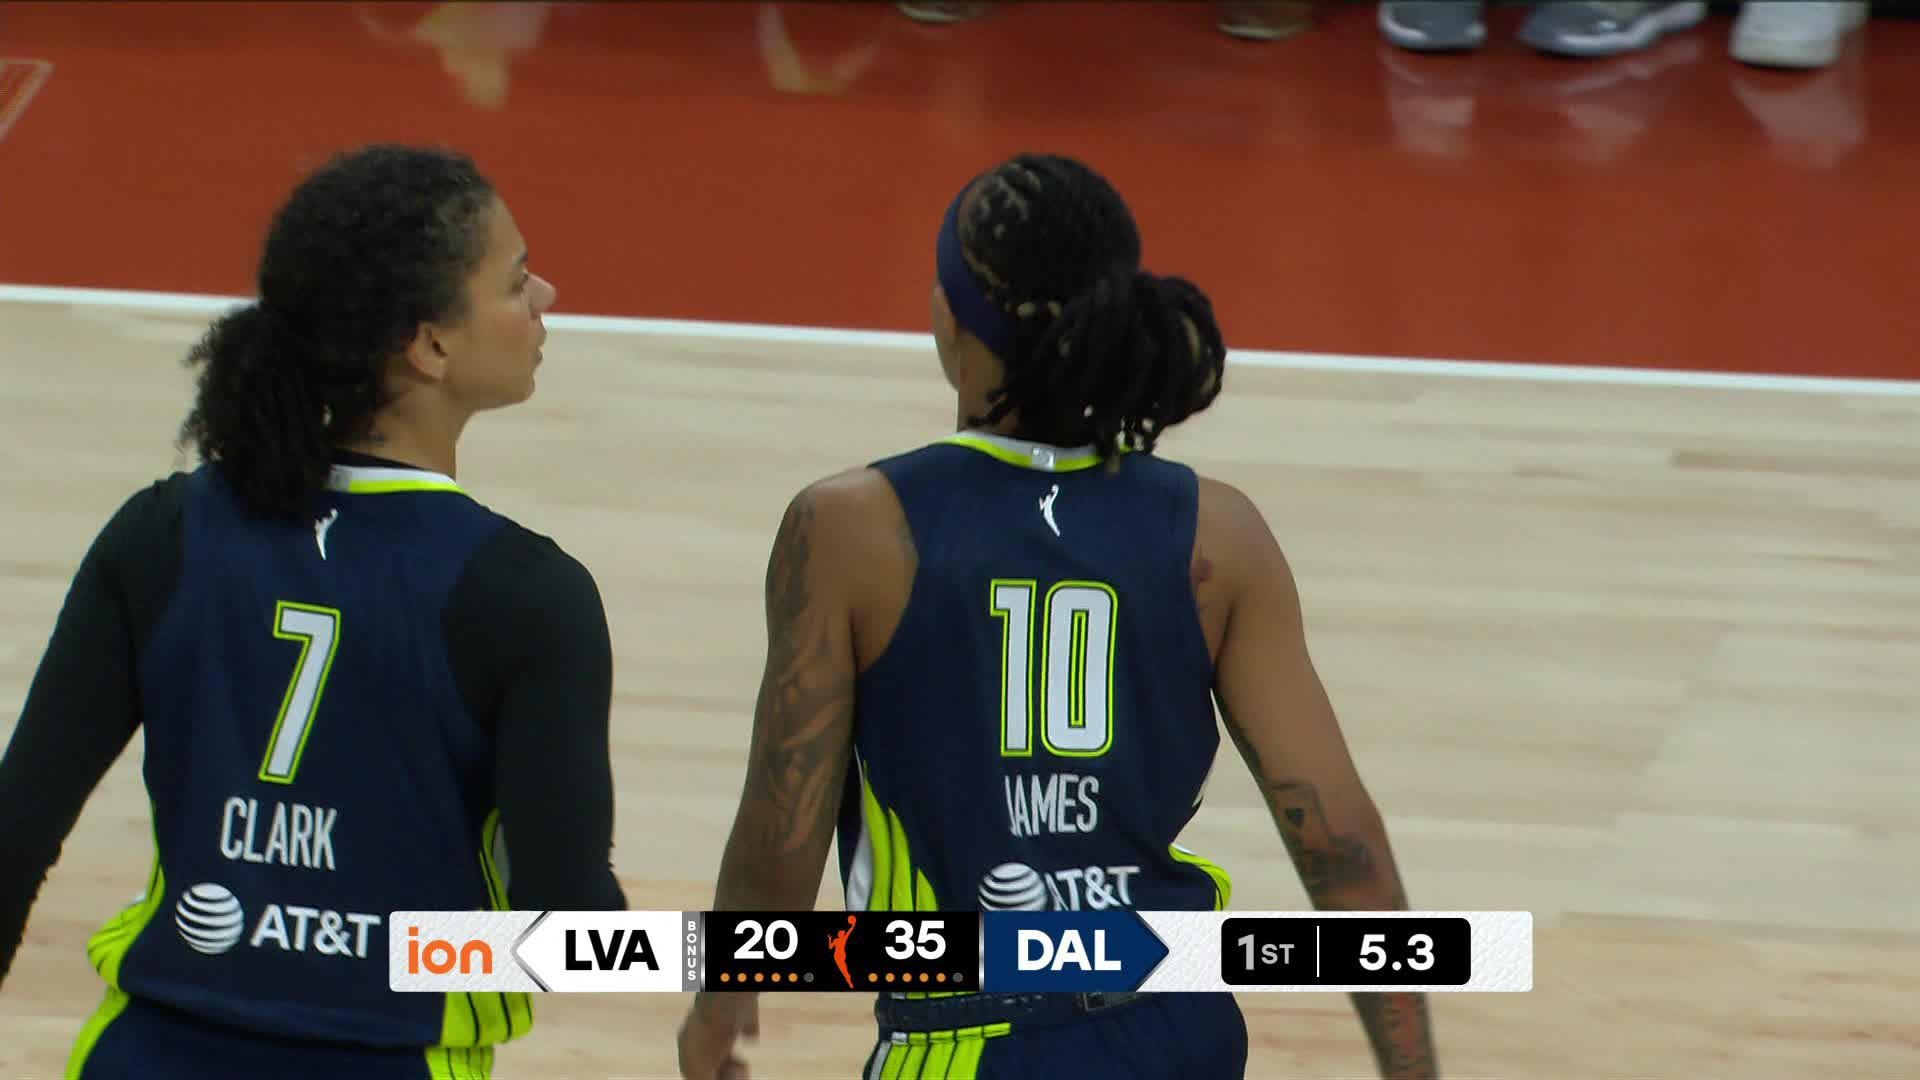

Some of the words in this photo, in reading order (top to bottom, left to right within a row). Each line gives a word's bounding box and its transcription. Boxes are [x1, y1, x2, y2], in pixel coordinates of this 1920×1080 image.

[259, 601, 341, 784] 7
[990, 579, 1118, 757] 10
[220, 796, 337, 871] CLARK
[250, 903, 382, 959] AT&T
